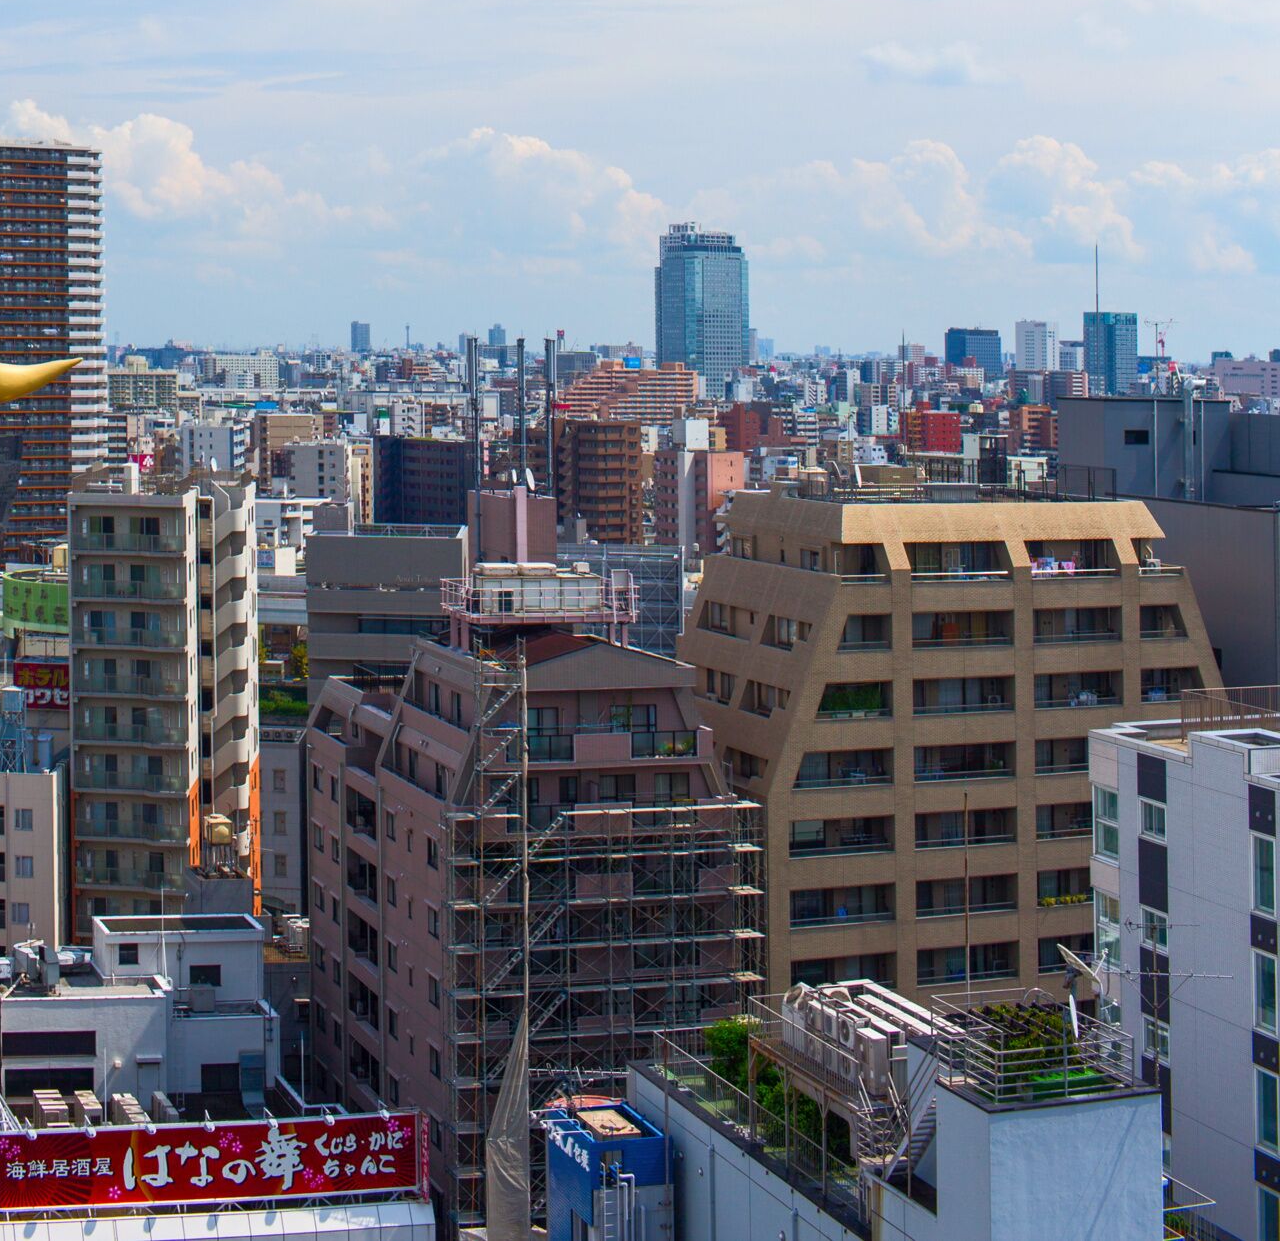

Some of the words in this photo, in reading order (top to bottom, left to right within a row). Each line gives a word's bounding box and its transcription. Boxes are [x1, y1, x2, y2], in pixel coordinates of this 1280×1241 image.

[17, 667, 69, 687] ホテル
[5, 1156, 114, 1179] 海鮮居酒屋
[123, 1128, 307, 1190] はなの舞
[322, 1155, 397, 1178] ちゃんこ
